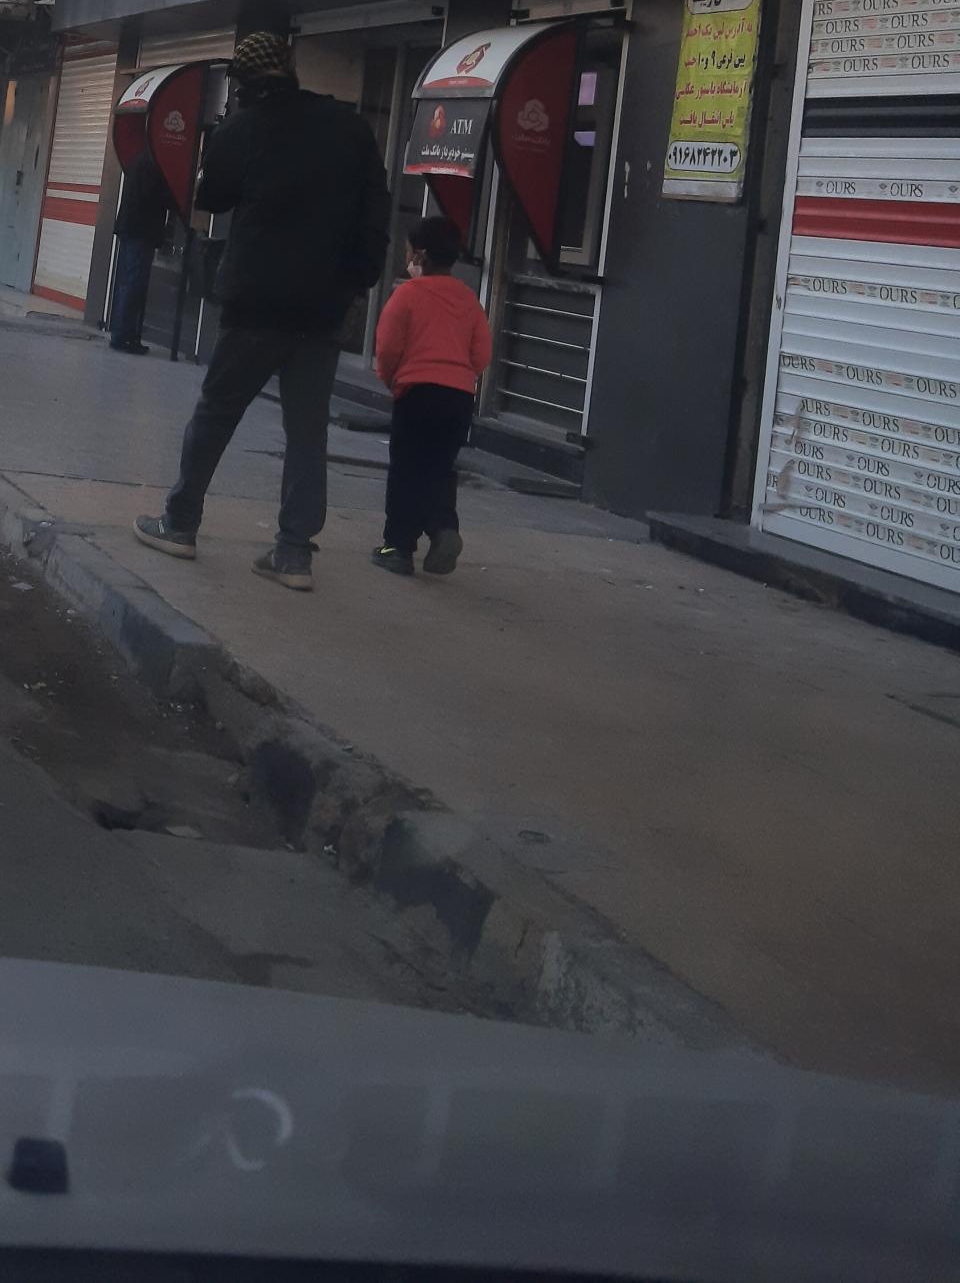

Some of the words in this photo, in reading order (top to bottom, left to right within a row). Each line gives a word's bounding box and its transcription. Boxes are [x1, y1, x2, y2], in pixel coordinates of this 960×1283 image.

[825, 19, 859, 35] OURS
[891, 13, 929, 29] OURS
[831, 38, 865, 54] OURS
[897, 33, 935, 49] OURS
[843, 58, 878, 73] OURS
[911, 54, 950, 69] OURS
[450, 119, 473, 135] ATM
[826, 180, 856, 195] OURS
[890, 182, 924, 198] OURS
[812, 278, 847, 294] OURS
[879, 286, 917, 304] OURS
[846, 365, 883, 385] OURS
[916, 377, 957, 399] OURS
[862, 412, 900, 433] OURS
[813, 422, 849, 442] OURS
[880, 437, 920, 460] OURS
[794, 440, 824, 460] OURS
[857, 456, 890, 478] OURS
[926, 473, 960, 496] OURS
[797, 460, 832, 481] OURS
[863, 477, 901, 500] OURS
[815, 487, 846, 509] OURS
[880, 505, 915, 528] OURS
[866, 521, 905, 546] OURS
